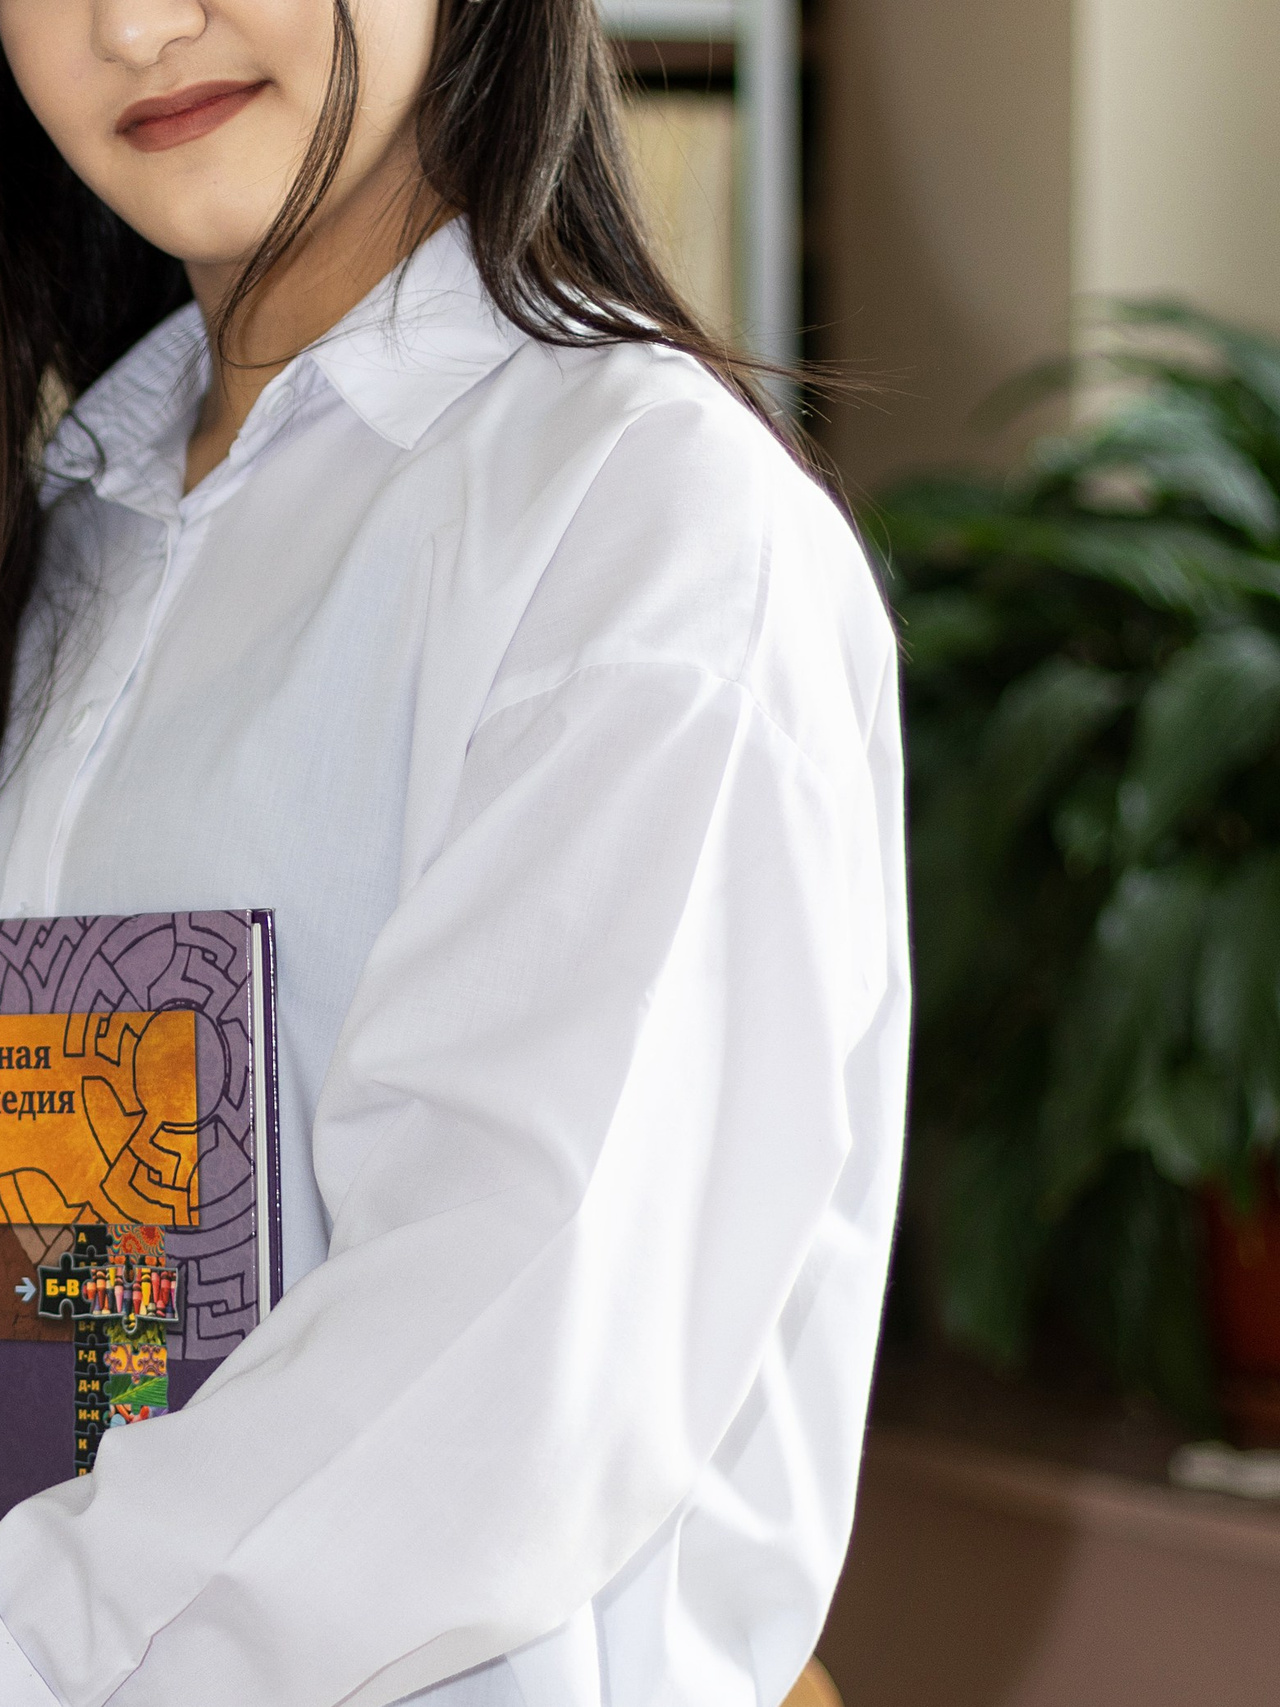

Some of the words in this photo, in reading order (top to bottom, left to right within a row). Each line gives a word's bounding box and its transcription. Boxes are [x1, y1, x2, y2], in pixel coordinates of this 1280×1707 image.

[77, 1232, 87, 1243] А
[45, 1278, 80, 1297] Б-В
[78, 1350, 97, 1363] Г-Д
[78, 1379, 100, 1392] Д-И
